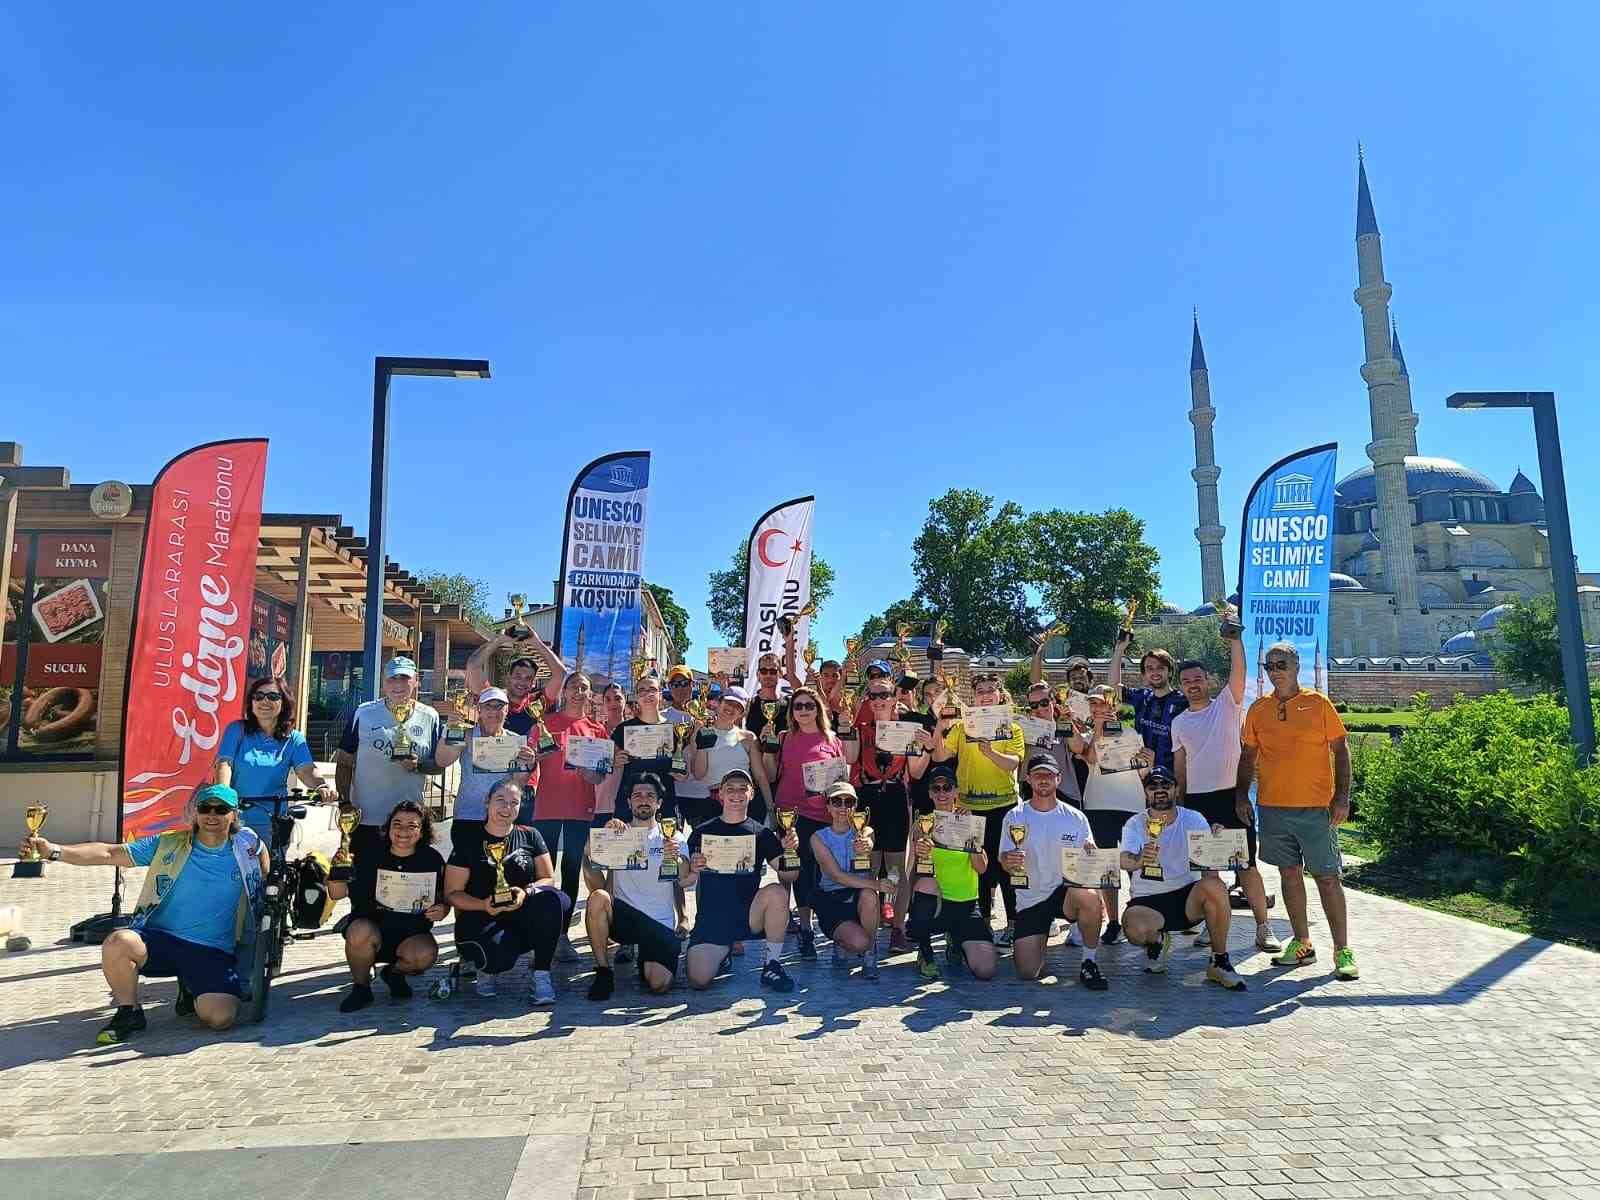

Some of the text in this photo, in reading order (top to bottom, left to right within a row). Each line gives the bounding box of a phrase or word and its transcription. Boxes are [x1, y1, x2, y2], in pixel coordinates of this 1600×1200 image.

[574, 496, 643, 524] UNESCO
[1251, 514, 1329, 544] UNESCO
[61, 543, 96, 553] DANA
[572, 543, 640, 572] CAMİİ
[1252, 542, 1325, 567] SELİMİYE
[55, 558, 98, 569] KIYMA
[153, 488, 192, 687] ULUSLARARASI
[575, 573, 637, 587] FARKINDALIK
[1263, 567, 1311, 589] CAMİİ
[172, 455, 245, 766] Edirne Maratonu
[570, 588, 637, 612] KOŞUSU
[1250, 599, 1320, 615] FARKINDALIK
[1254, 616, 1315, 641] KOŞUSU
[44, 663, 88, 674] SUCUK
[372, 739, 418, 751] QAR
